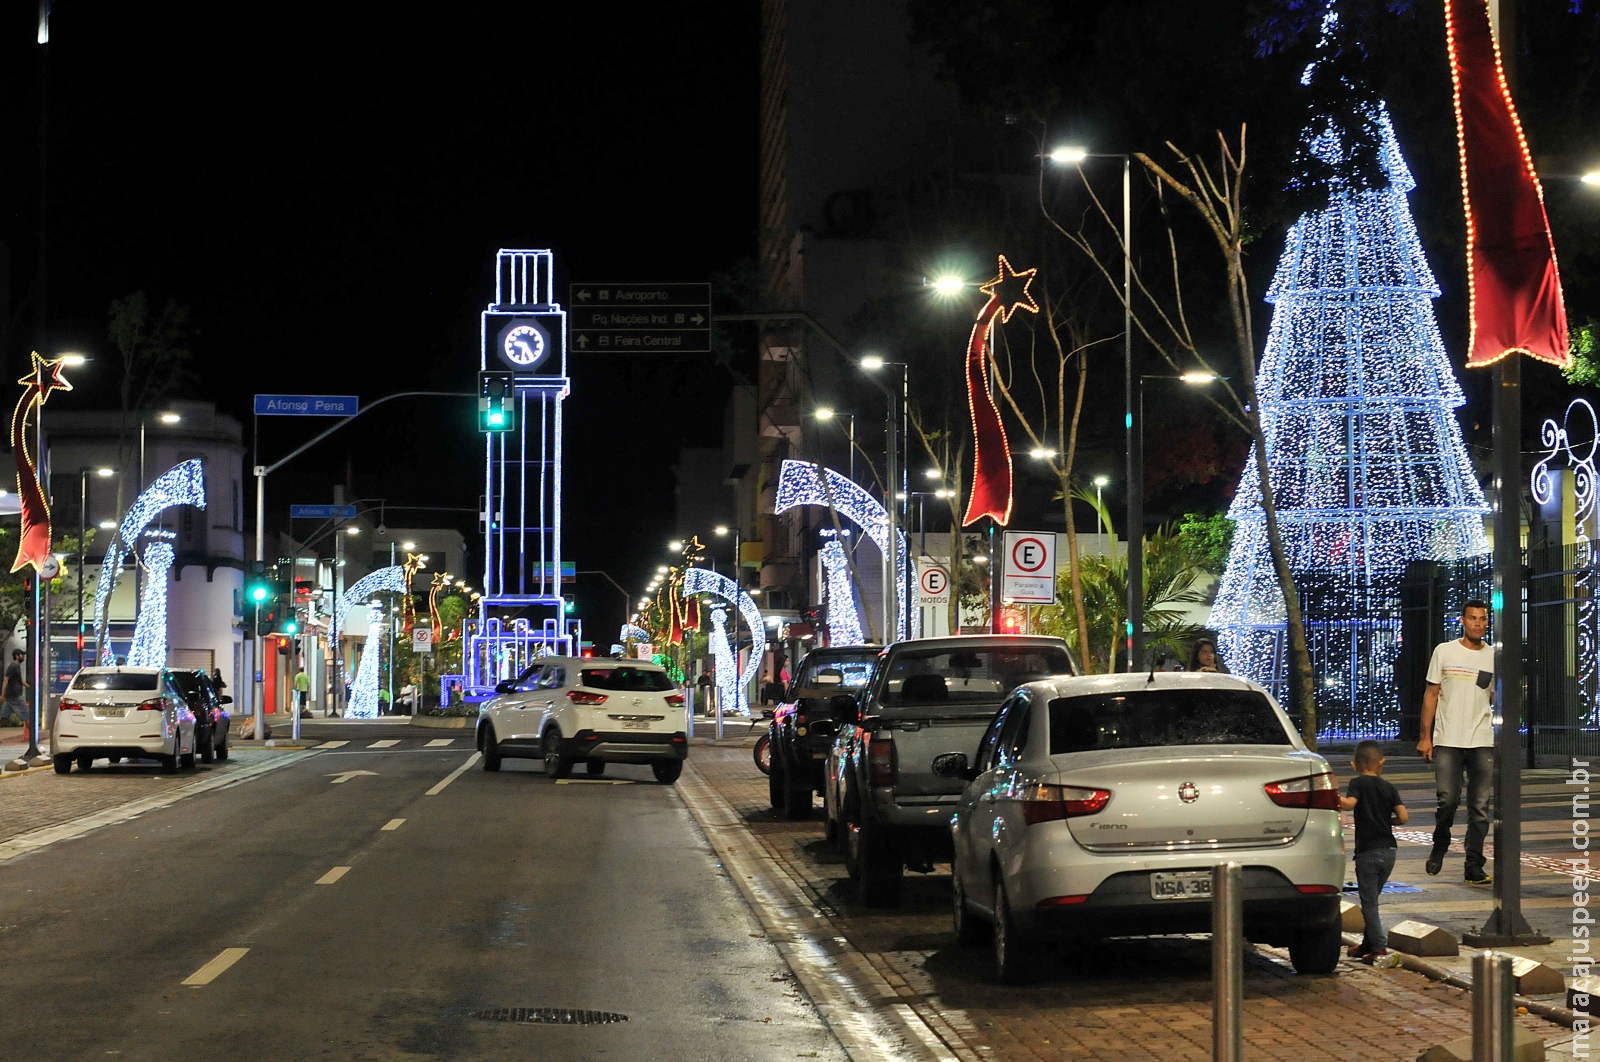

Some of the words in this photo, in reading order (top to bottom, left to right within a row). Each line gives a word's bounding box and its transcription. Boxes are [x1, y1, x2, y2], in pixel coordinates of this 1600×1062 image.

[615, 290, 668, 302] Aeroporto
[611, 313, 649, 326] Nações
[615, 335, 641, 346] Feira
[643, 335, 682, 346] Central
[267, 399, 308, 411] Afonso
[315, 400, 345, 411] Pena
[1024, 545, 1036, 565] E
[929, 573, 939, 589] E
[920, 596, 948, 604] MOTOS
